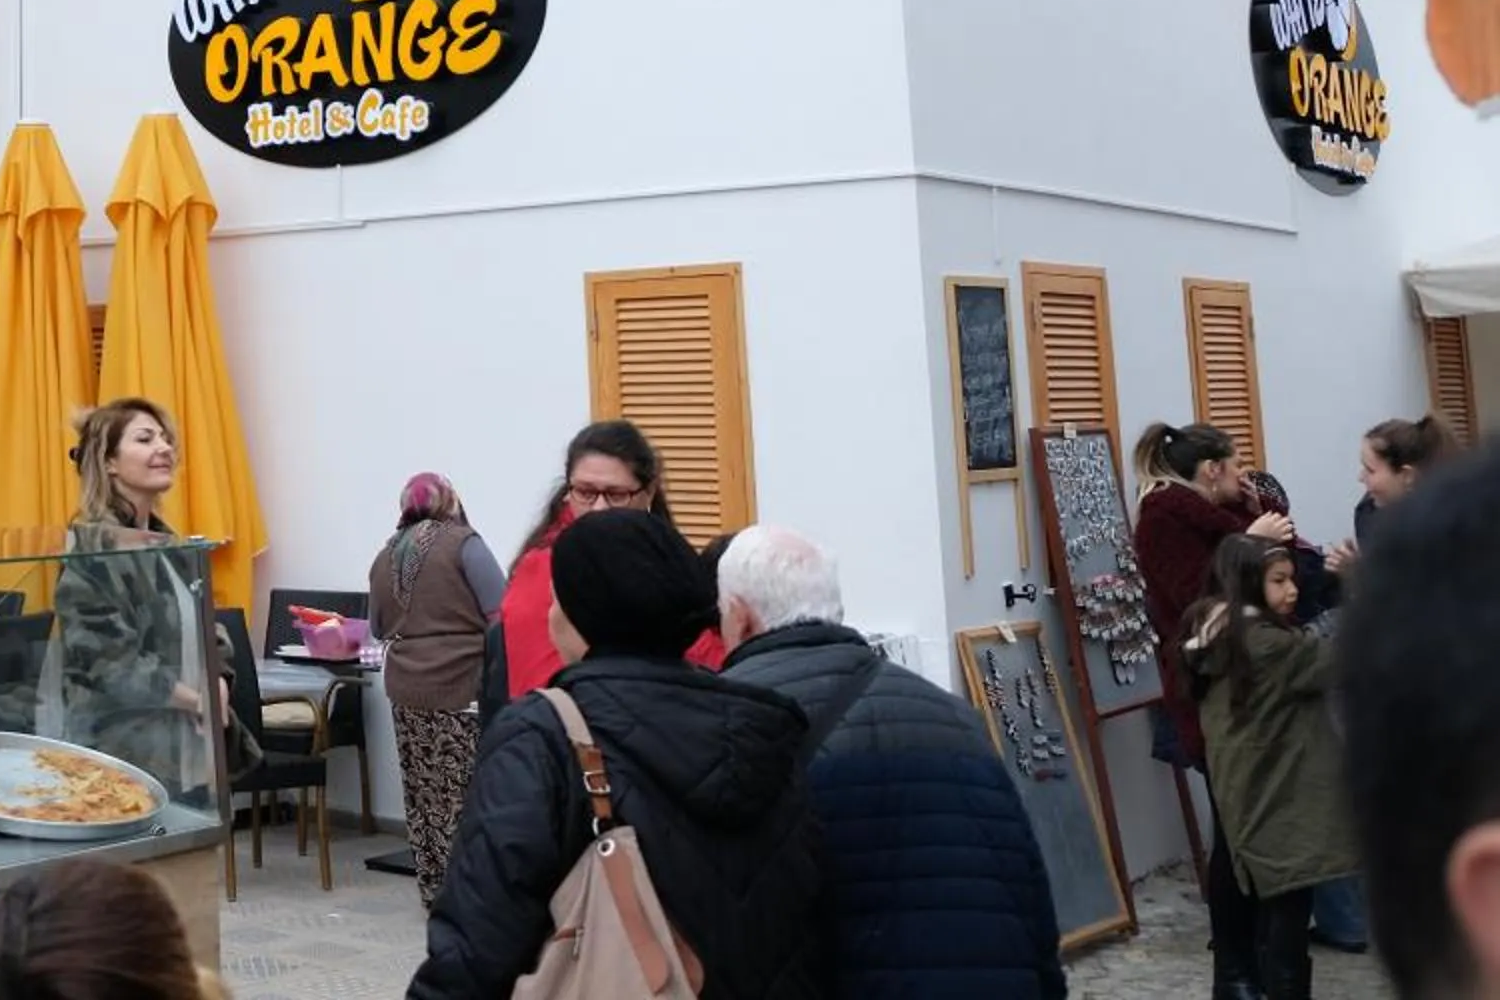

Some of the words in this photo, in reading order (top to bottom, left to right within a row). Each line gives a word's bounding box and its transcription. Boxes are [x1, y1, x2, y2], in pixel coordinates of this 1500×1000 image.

[245, 99, 324, 149] Hotel
[326, 101, 355, 137] &
[357, 87, 430, 141] Cafe
[1288, 46, 1392, 145] ORANGE
